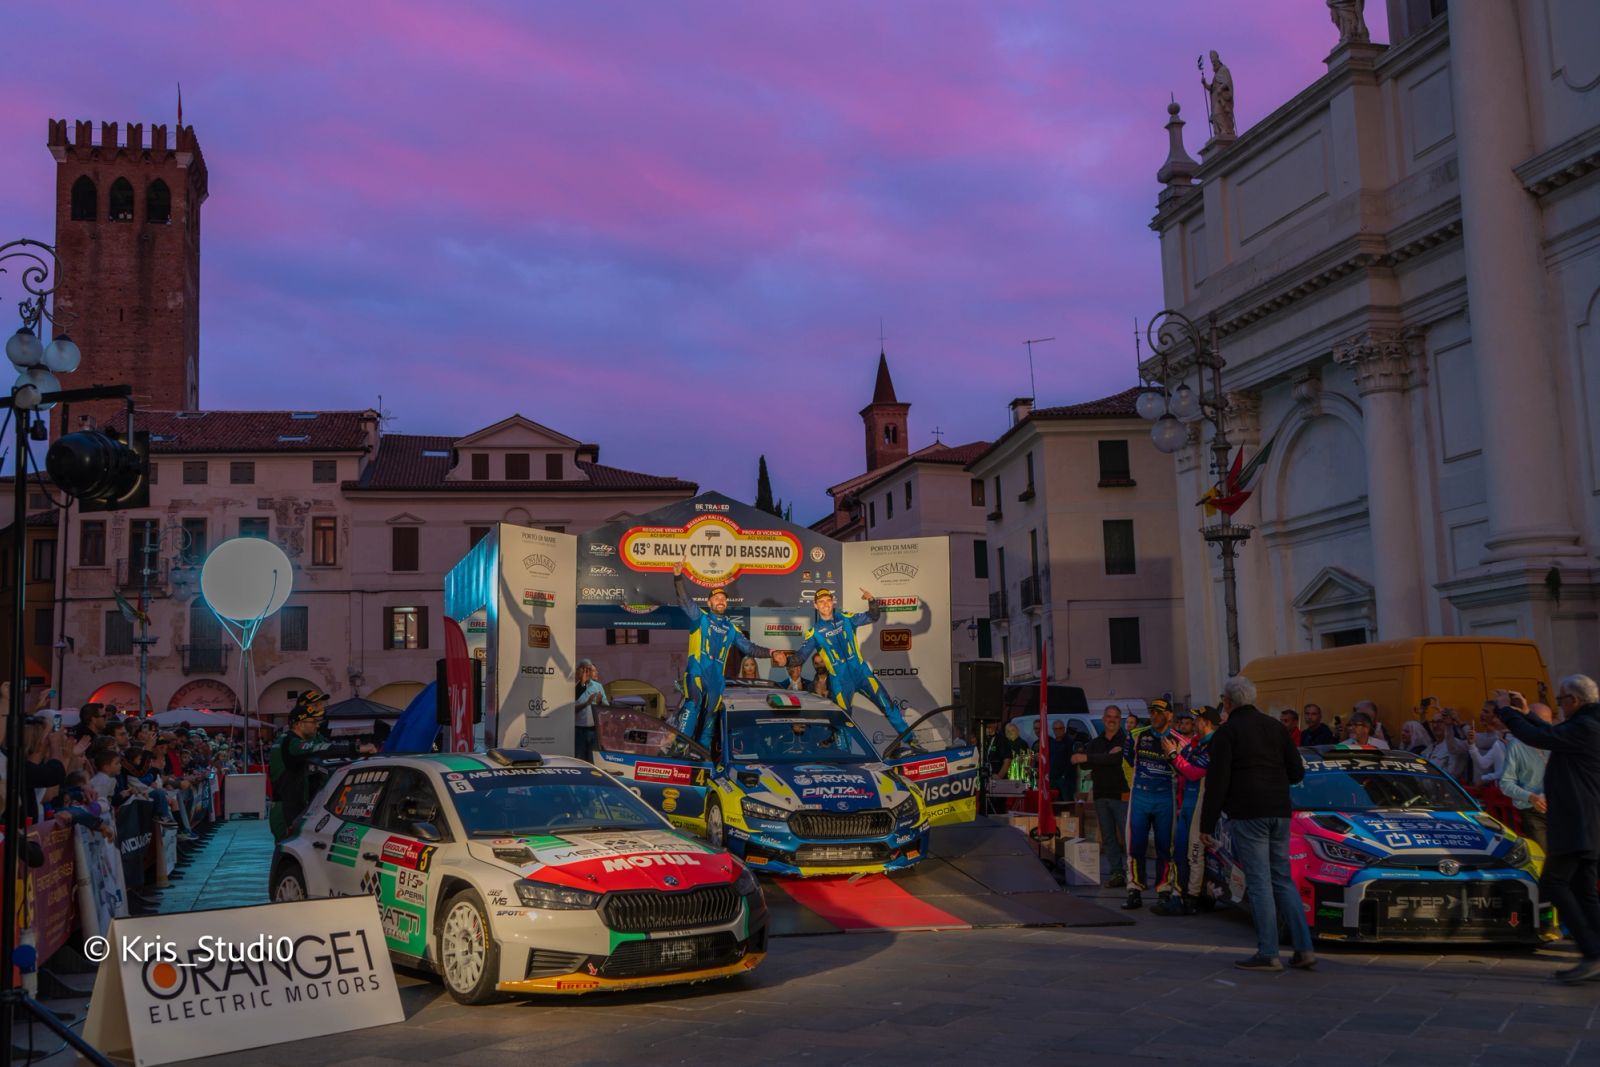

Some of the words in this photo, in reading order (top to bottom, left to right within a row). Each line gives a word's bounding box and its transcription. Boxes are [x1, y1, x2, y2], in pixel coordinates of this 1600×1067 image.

[632, 542, 651, 556] 43°
[654, 543, 687, 556] RALLY
[725, 545, 737, 557] DI
[740, 545, 791, 558] BASSANO
[524, 590, 555, 601] BRESOLIN
[521, 666, 555, 675] RECOLD
[873, 668, 919, 676] RECOLD
[468, 771, 493, 779] MS
[492, 768, 582, 778] MUNARETTO
[638, 767, 672, 775] BRESOLIN
[696, 768, 705, 785] 4
[457, 782, 466, 791] 5
[802, 786, 858, 797] PINTA
[335, 786, 353, 815] 5
[420, 846, 433, 871] 5
[601, 853, 701, 873] MOTUL
[491, 897, 508, 906] MS
[1396, 896, 1444, 909] STEP
[141, 929, 374, 1000] ORANGE1
[149, 989, 273, 1024] ELECTRIC
[286, 973, 381, 1004] MOTORS
